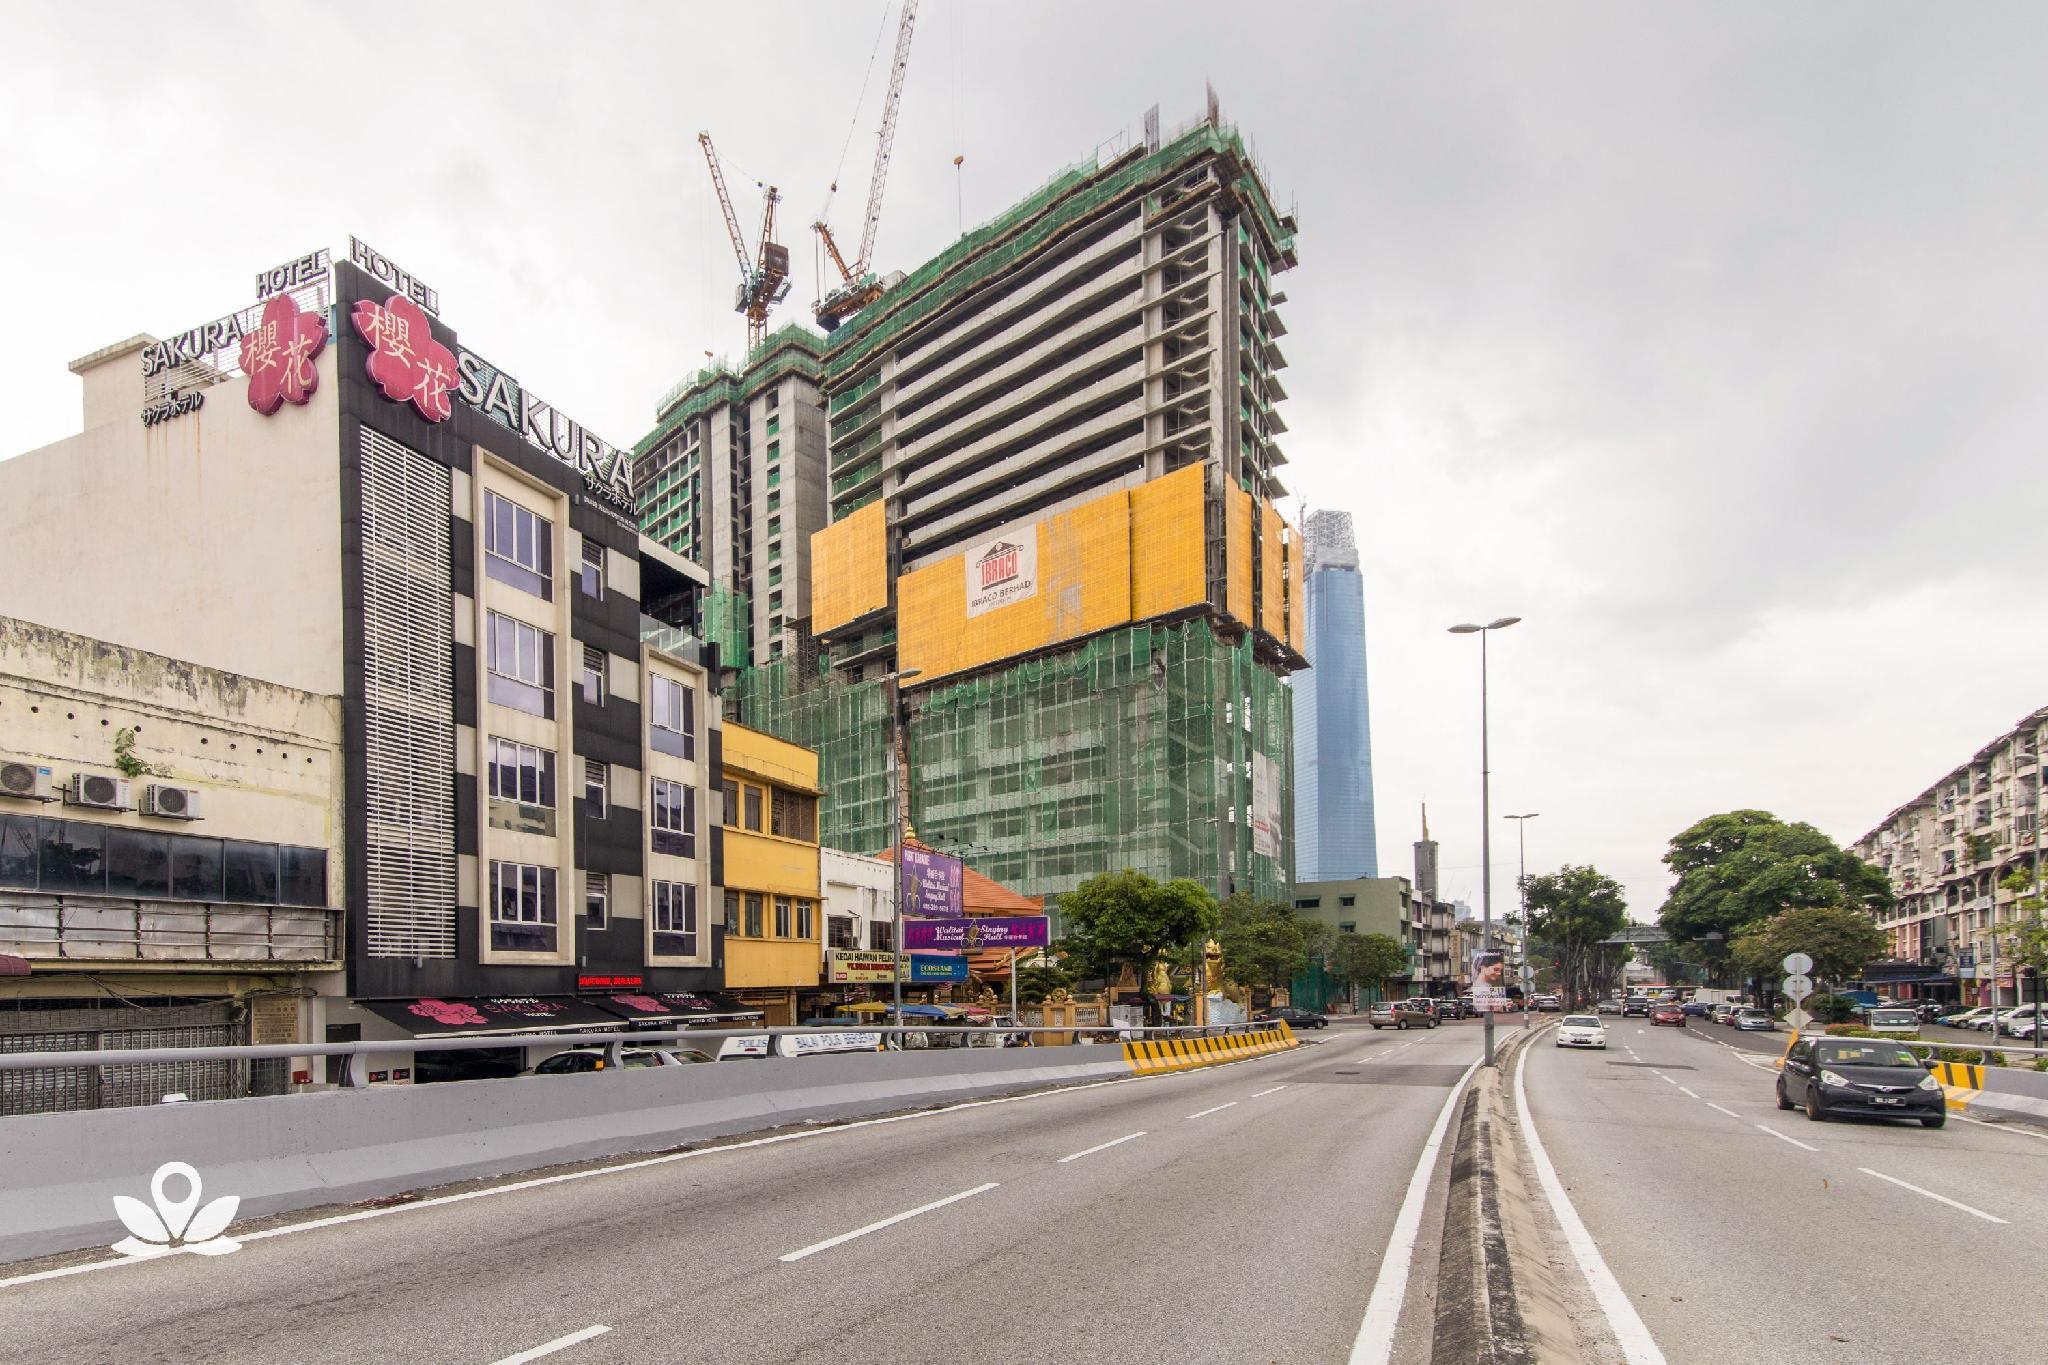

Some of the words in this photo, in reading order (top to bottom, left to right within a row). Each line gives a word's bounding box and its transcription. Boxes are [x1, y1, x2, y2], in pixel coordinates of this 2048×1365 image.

[256, 252, 327, 298] HOTEL
[353, 238, 438, 315] HOTEL
[140, 313, 244, 377] SAKURA
[458, 351, 635, 499] SAKURA
[999, 580, 1031, 598] BERHAD
[836, 952, 854, 961] KEDAI
[737, 1040, 768, 1048] POLIS
